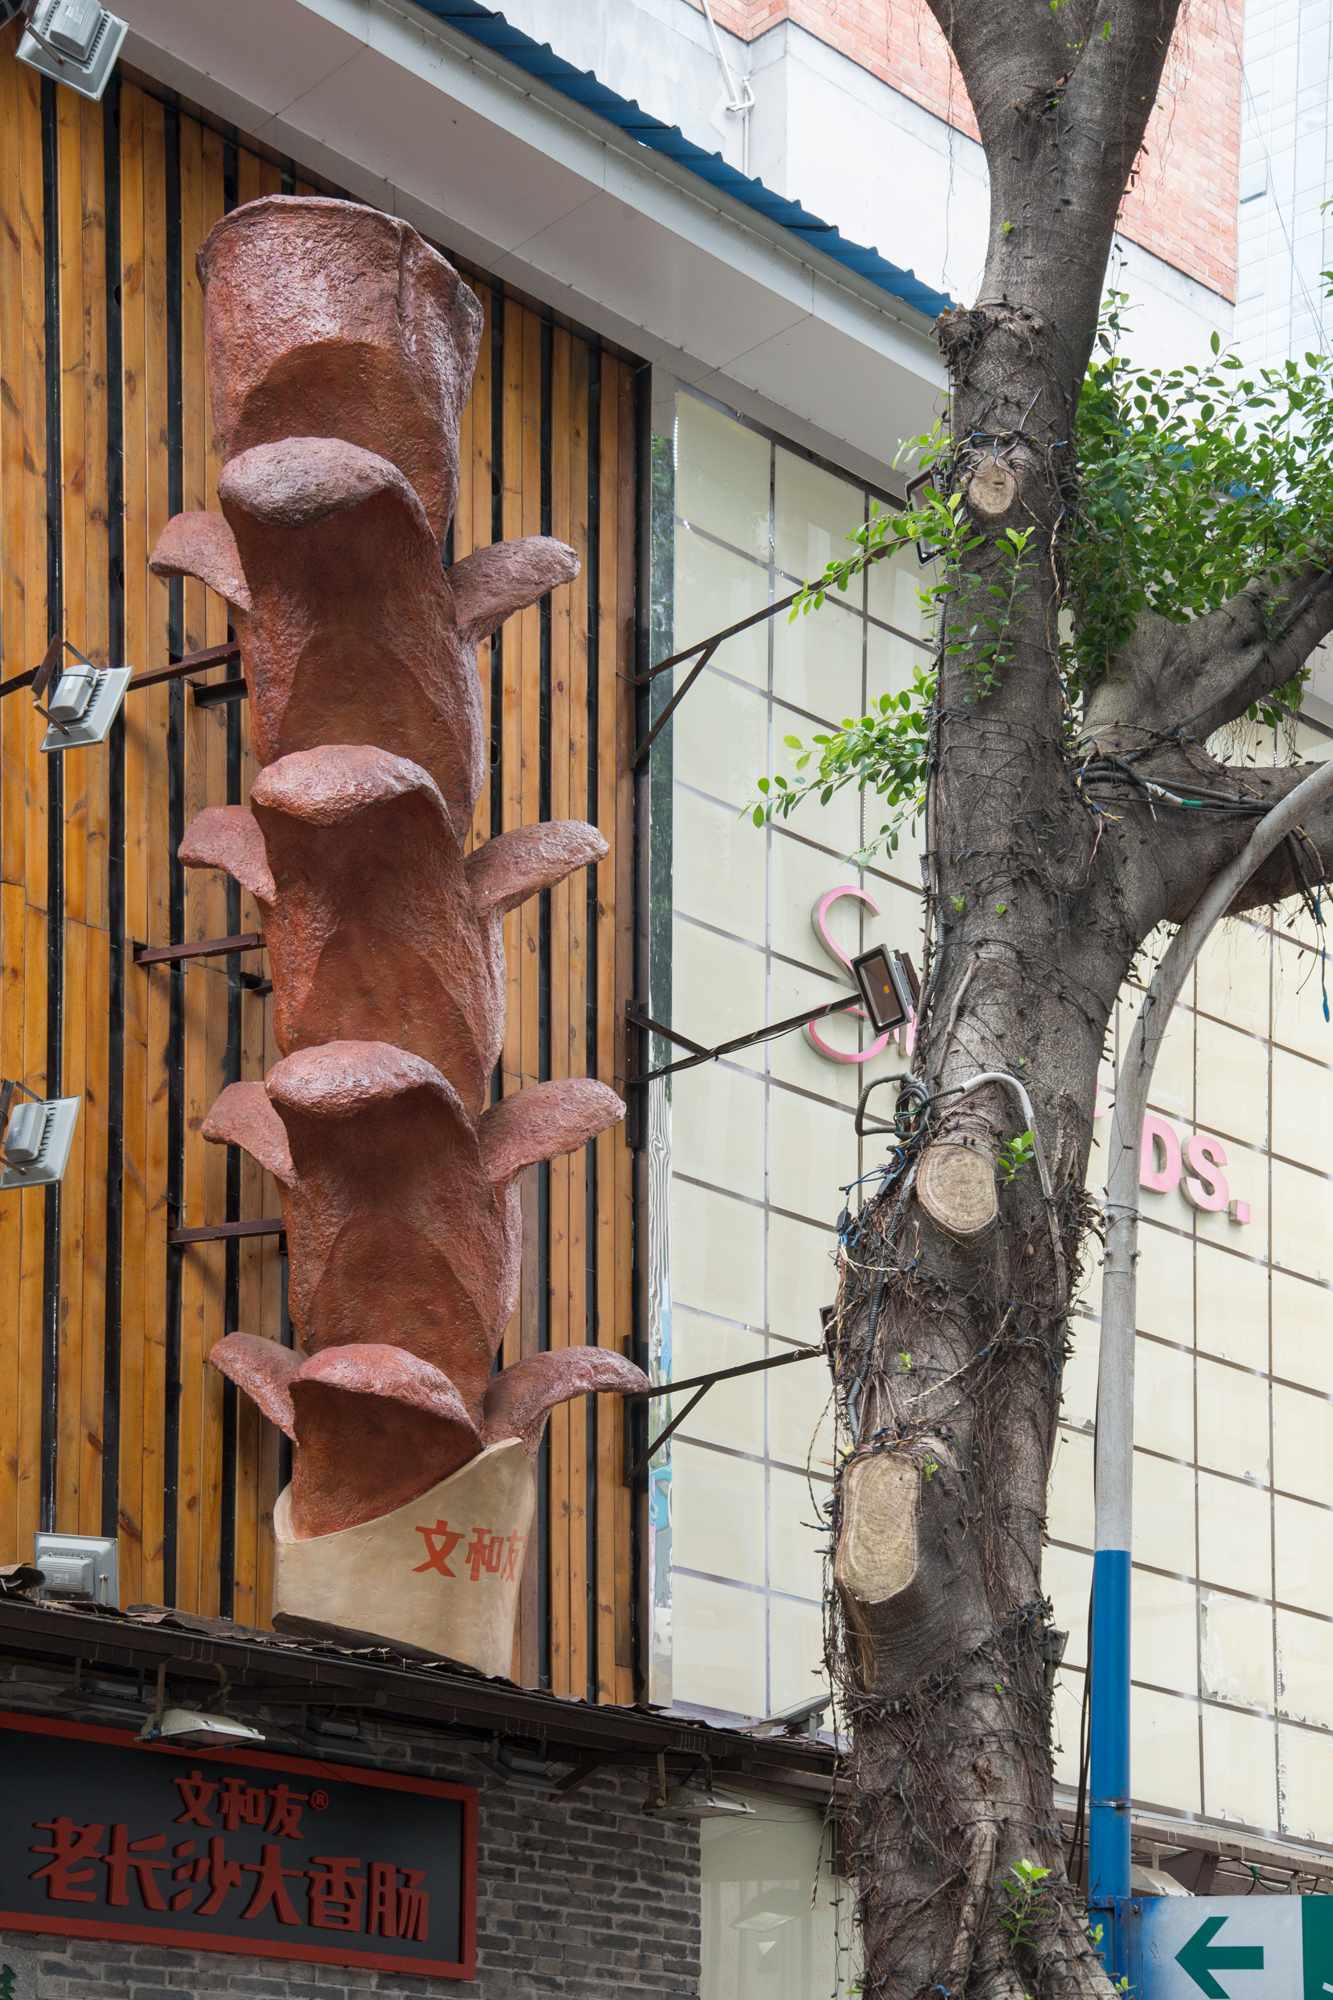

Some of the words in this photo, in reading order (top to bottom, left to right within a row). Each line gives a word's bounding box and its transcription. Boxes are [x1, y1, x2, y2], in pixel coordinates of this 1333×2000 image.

[411, 1519, 525, 1582] 文和友
[29, 1816, 429, 1942] 老长沙大香肠
